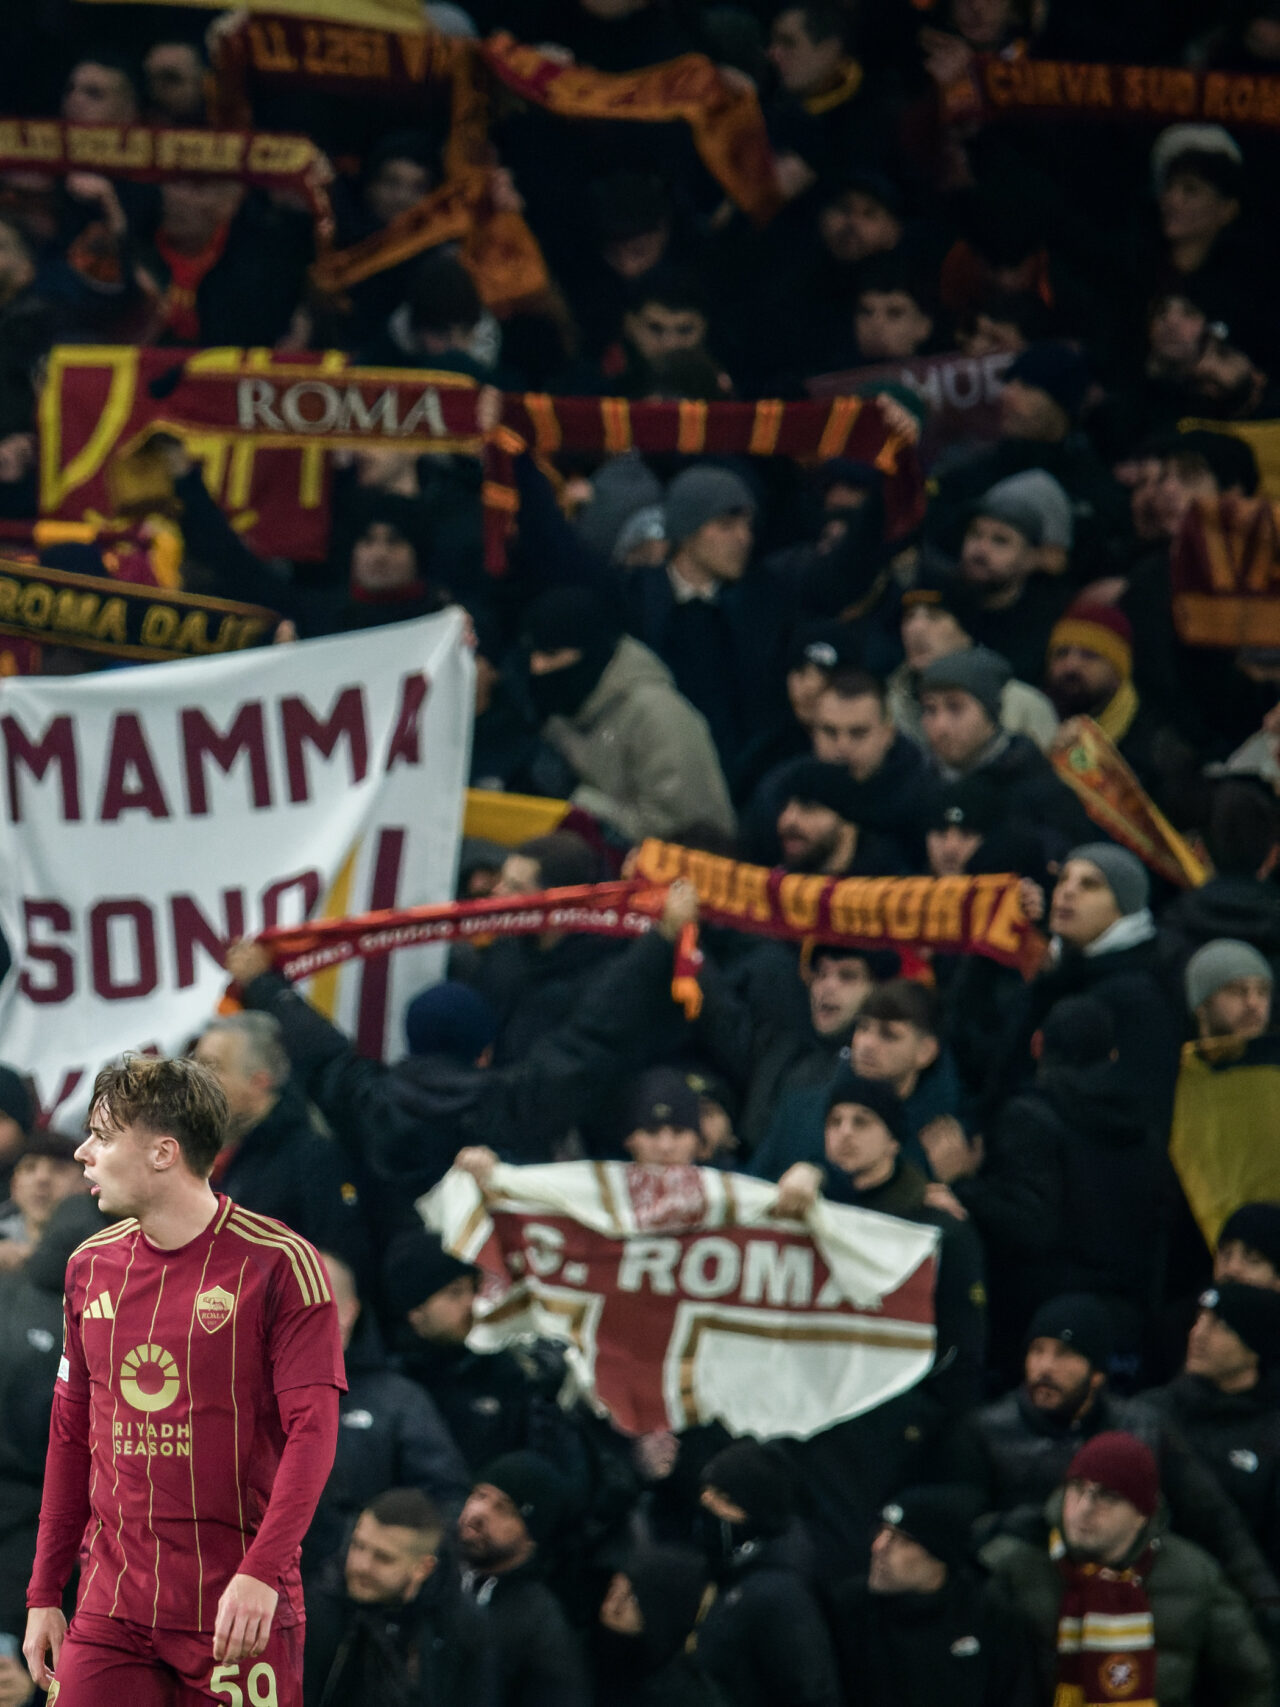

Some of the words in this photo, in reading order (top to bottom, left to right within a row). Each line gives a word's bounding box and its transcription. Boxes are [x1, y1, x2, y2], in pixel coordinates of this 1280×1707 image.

[1122, 64, 1196, 117] SUD
[236, 377, 450, 438] ROMA
[20, 870, 322, 1003] SONO
[828, 872, 1022, 954] MORTE
[114, 1440, 191, 1457] SEASON
[115, 1421, 190, 1438] RIYADH
[209, 1661, 279, 1707] 59
